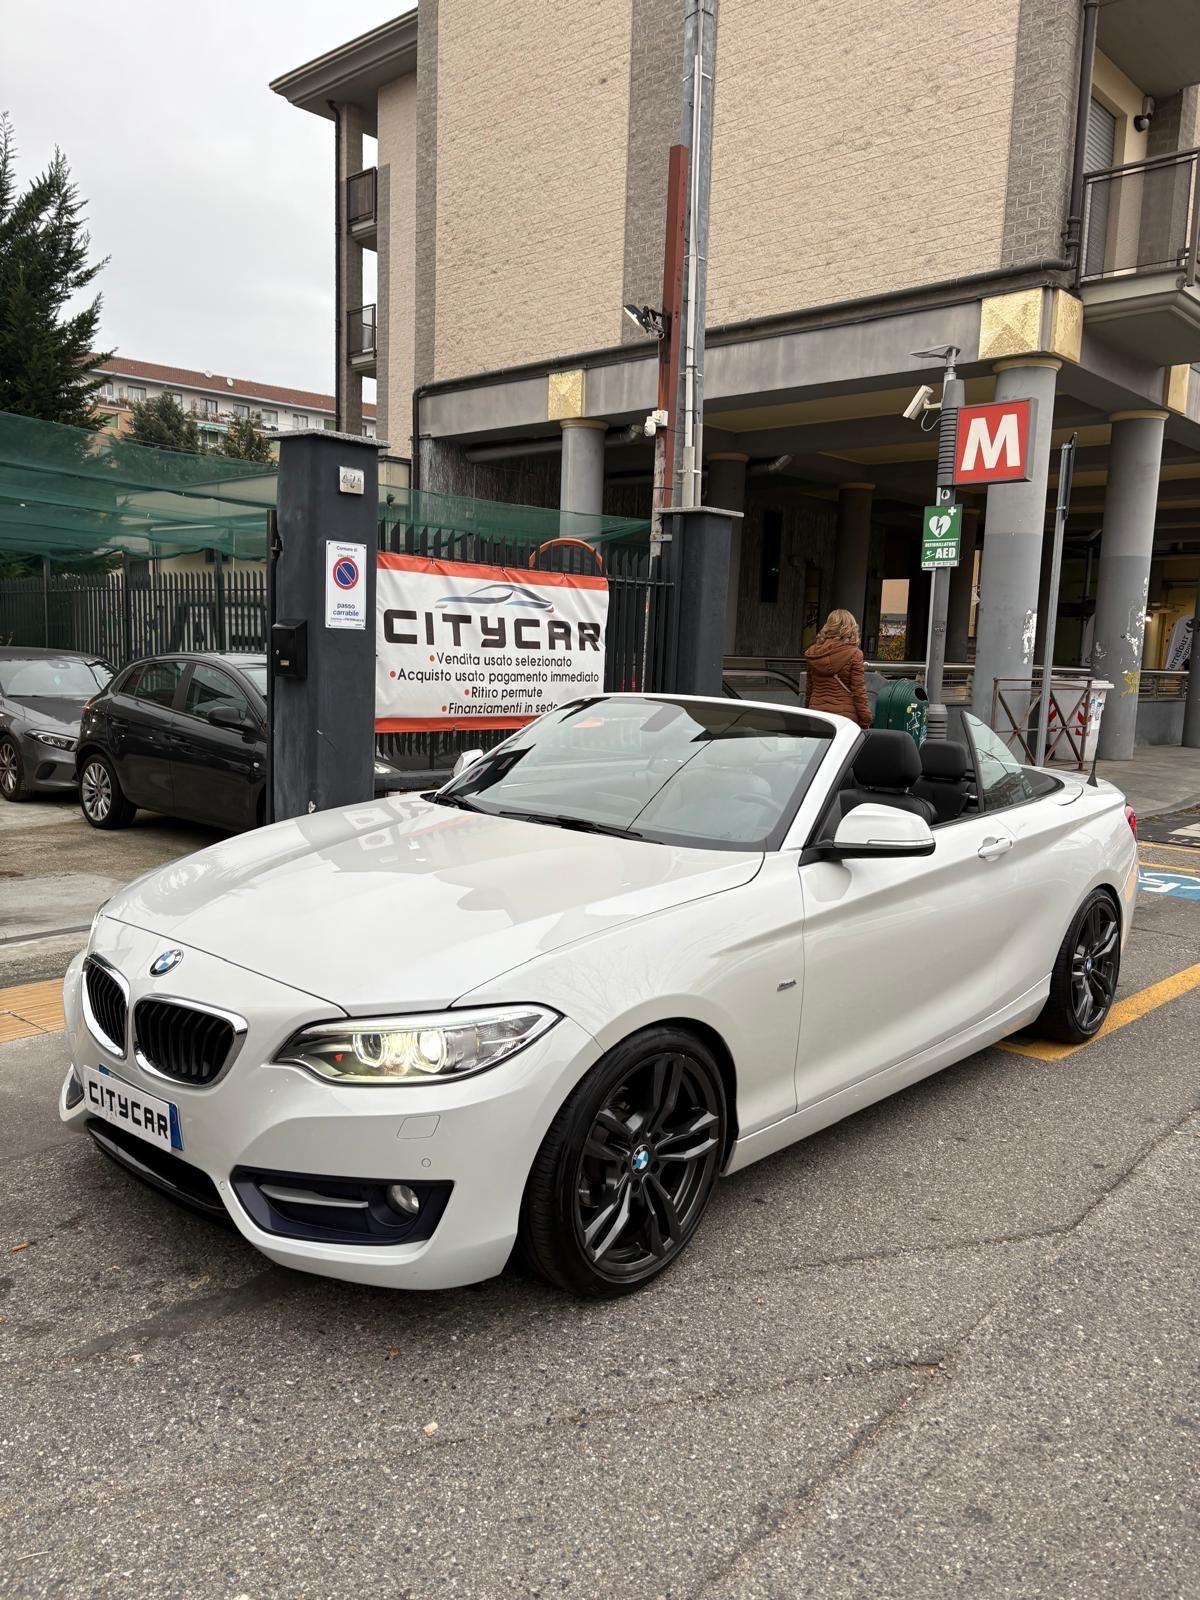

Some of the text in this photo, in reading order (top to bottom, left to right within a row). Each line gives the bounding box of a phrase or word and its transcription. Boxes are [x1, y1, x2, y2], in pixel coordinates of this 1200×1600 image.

[961, 413, 1020, 471] M
[935, 547, 956, 558] AED
[384, 608, 601, 651] CITYCAR
[436, 652, 572, 667] Vendita usato selezionato
[397, 668, 599, 686] Acquisto usato pagamento immediato
[471, 687, 543, 700] Ritiro permute
[448, 702, 522, 715] Finanziamenti
[525, 702, 533, 713] in
[89, 1080, 168, 1140] CITYCAR
